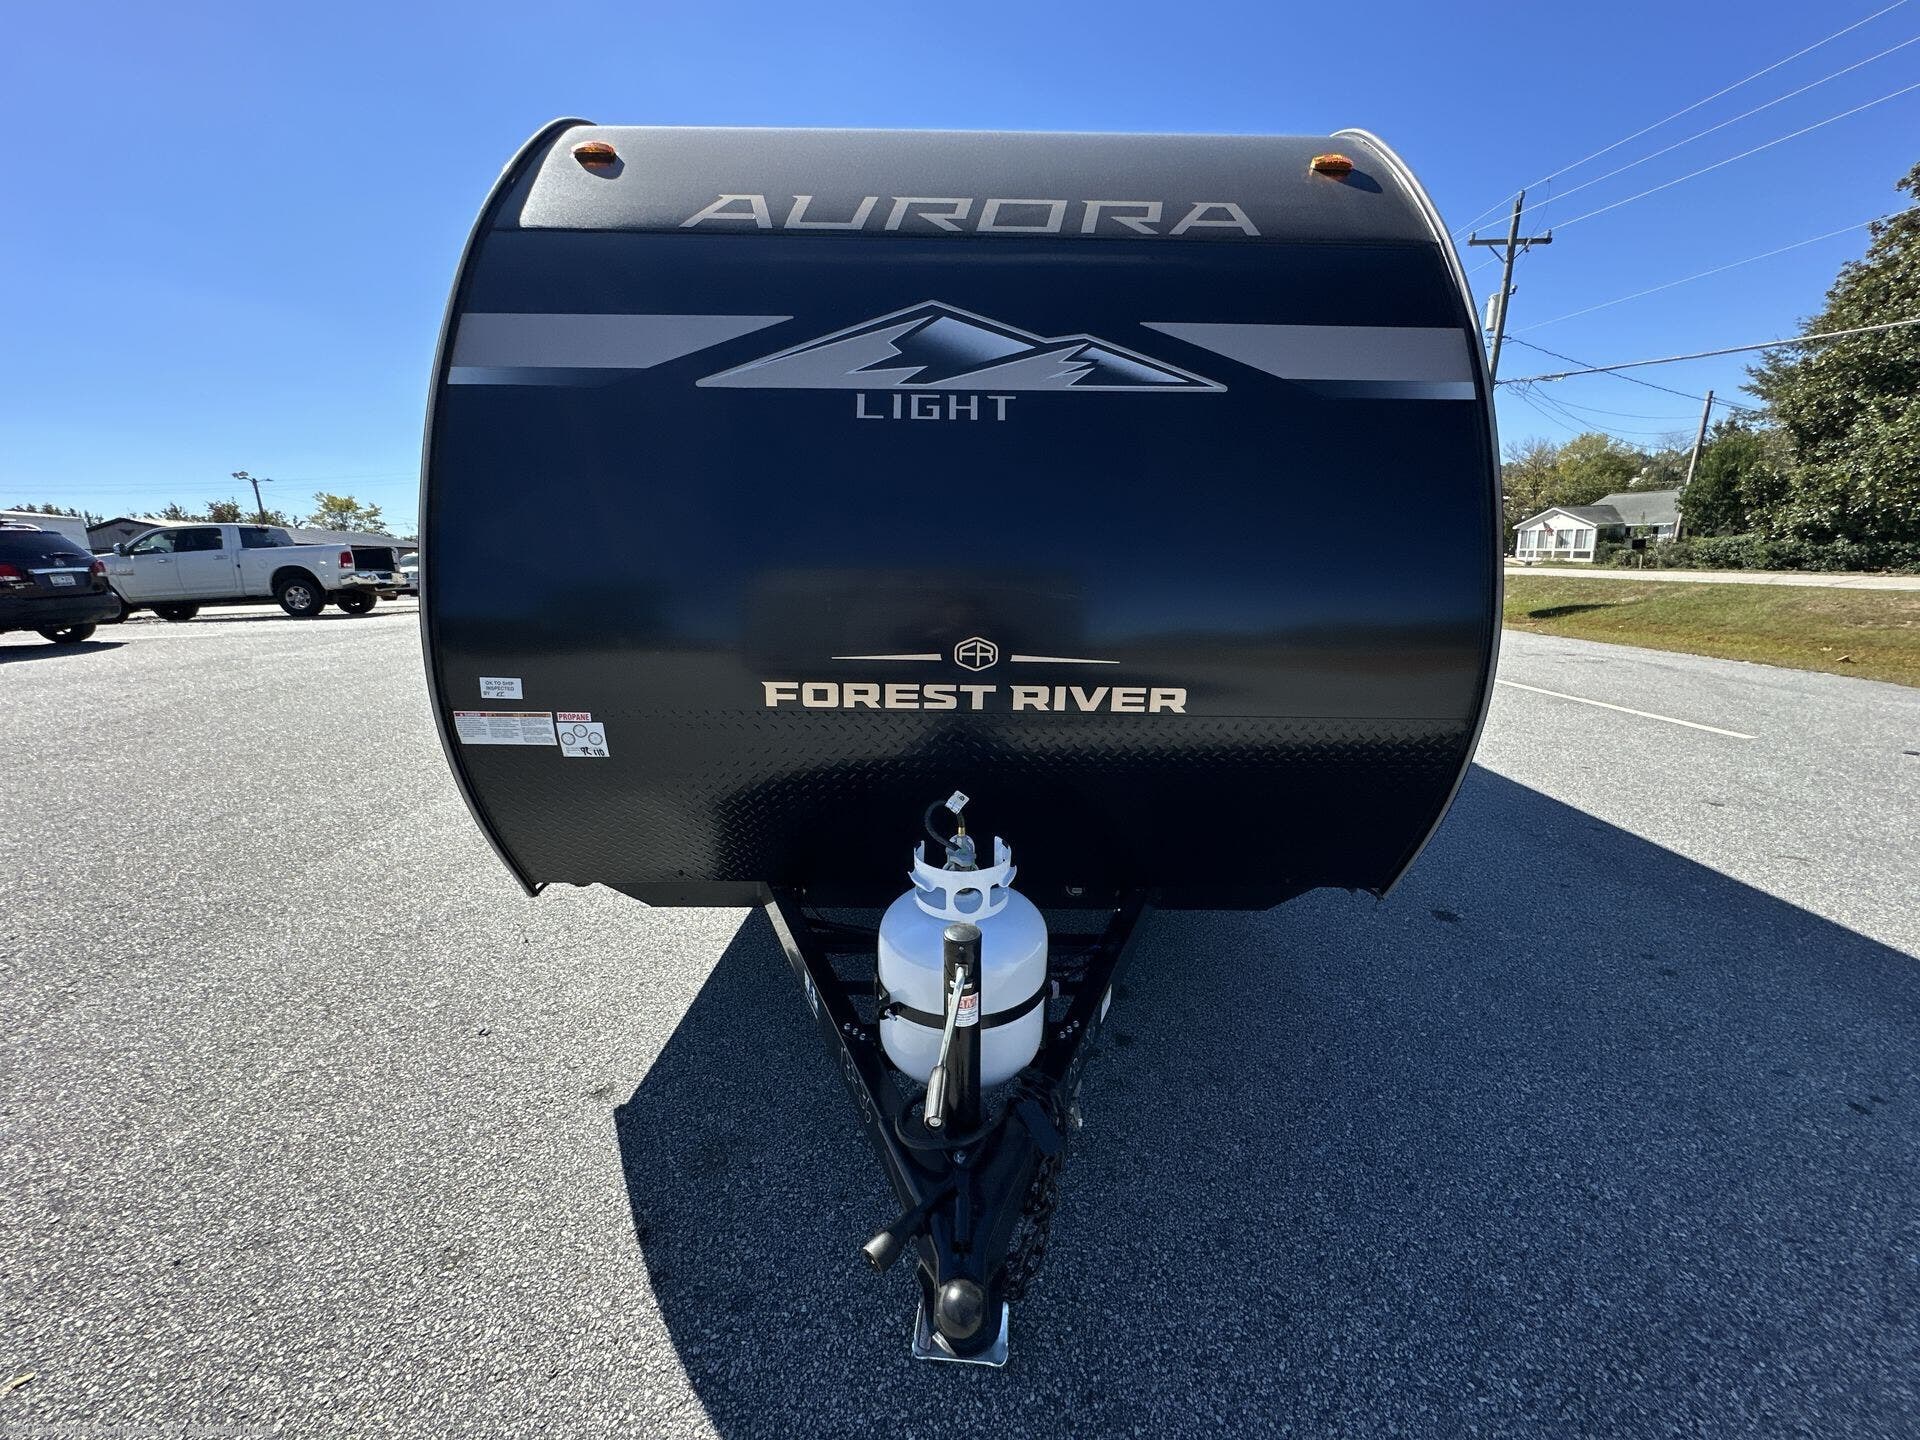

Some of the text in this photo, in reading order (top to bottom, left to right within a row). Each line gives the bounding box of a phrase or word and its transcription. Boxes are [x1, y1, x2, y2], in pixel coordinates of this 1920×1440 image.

[679, 194, 1261, 236] AURORA
[856, 393, 1017, 421] LIGHT
[761, 681, 1187, 713] FOREST RIVER
[558, 713, 590, 721] PROPANE
